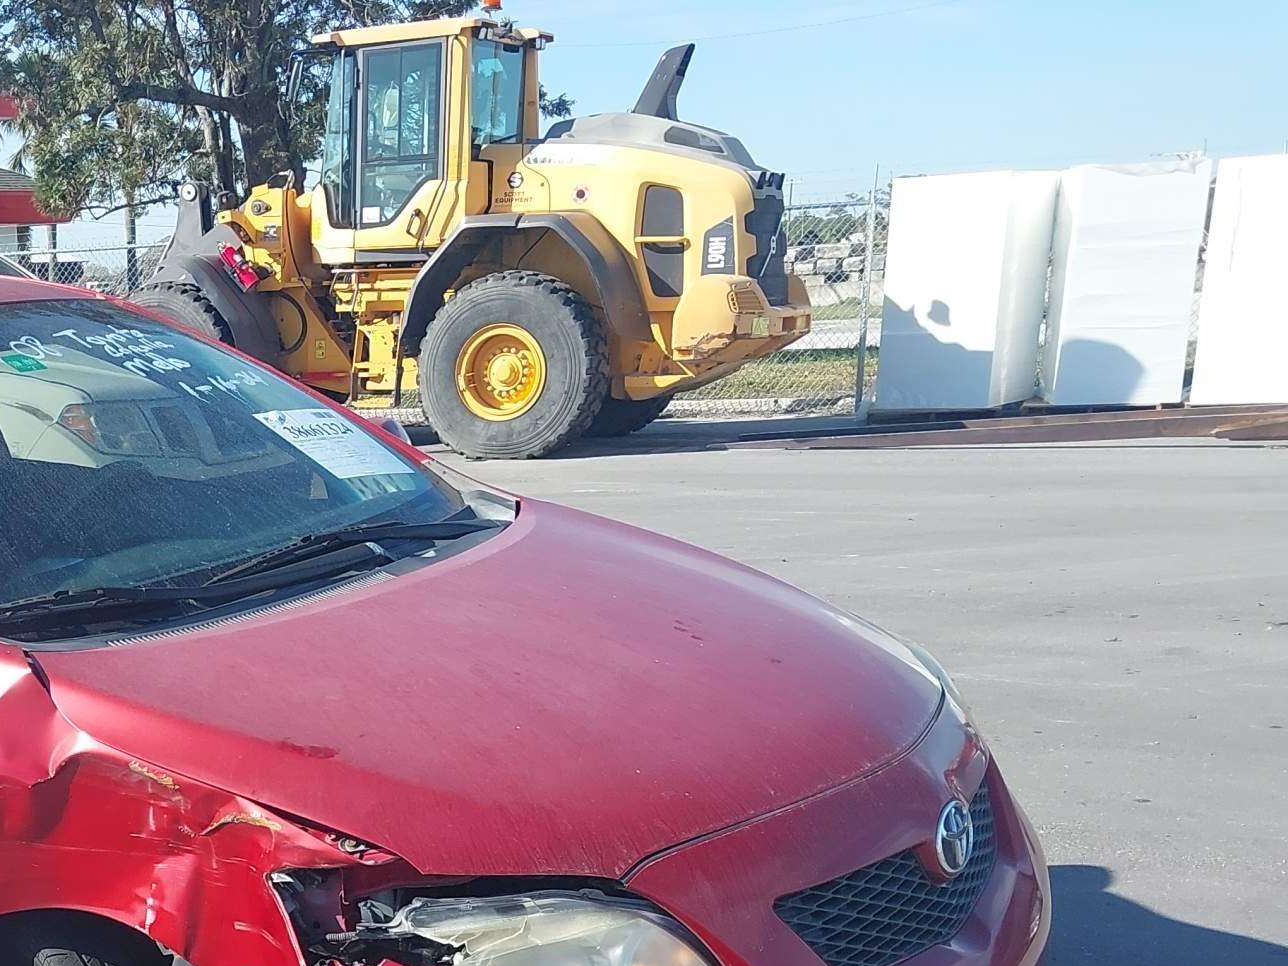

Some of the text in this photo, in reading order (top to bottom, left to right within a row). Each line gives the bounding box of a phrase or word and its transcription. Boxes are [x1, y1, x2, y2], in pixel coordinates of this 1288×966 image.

[495, 196, 533, 204] EQUIPMENT
[706, 236, 727, 269] L90H
[52, 325, 151, 349] Toyota
[283, 422, 354, 440] 38661324
